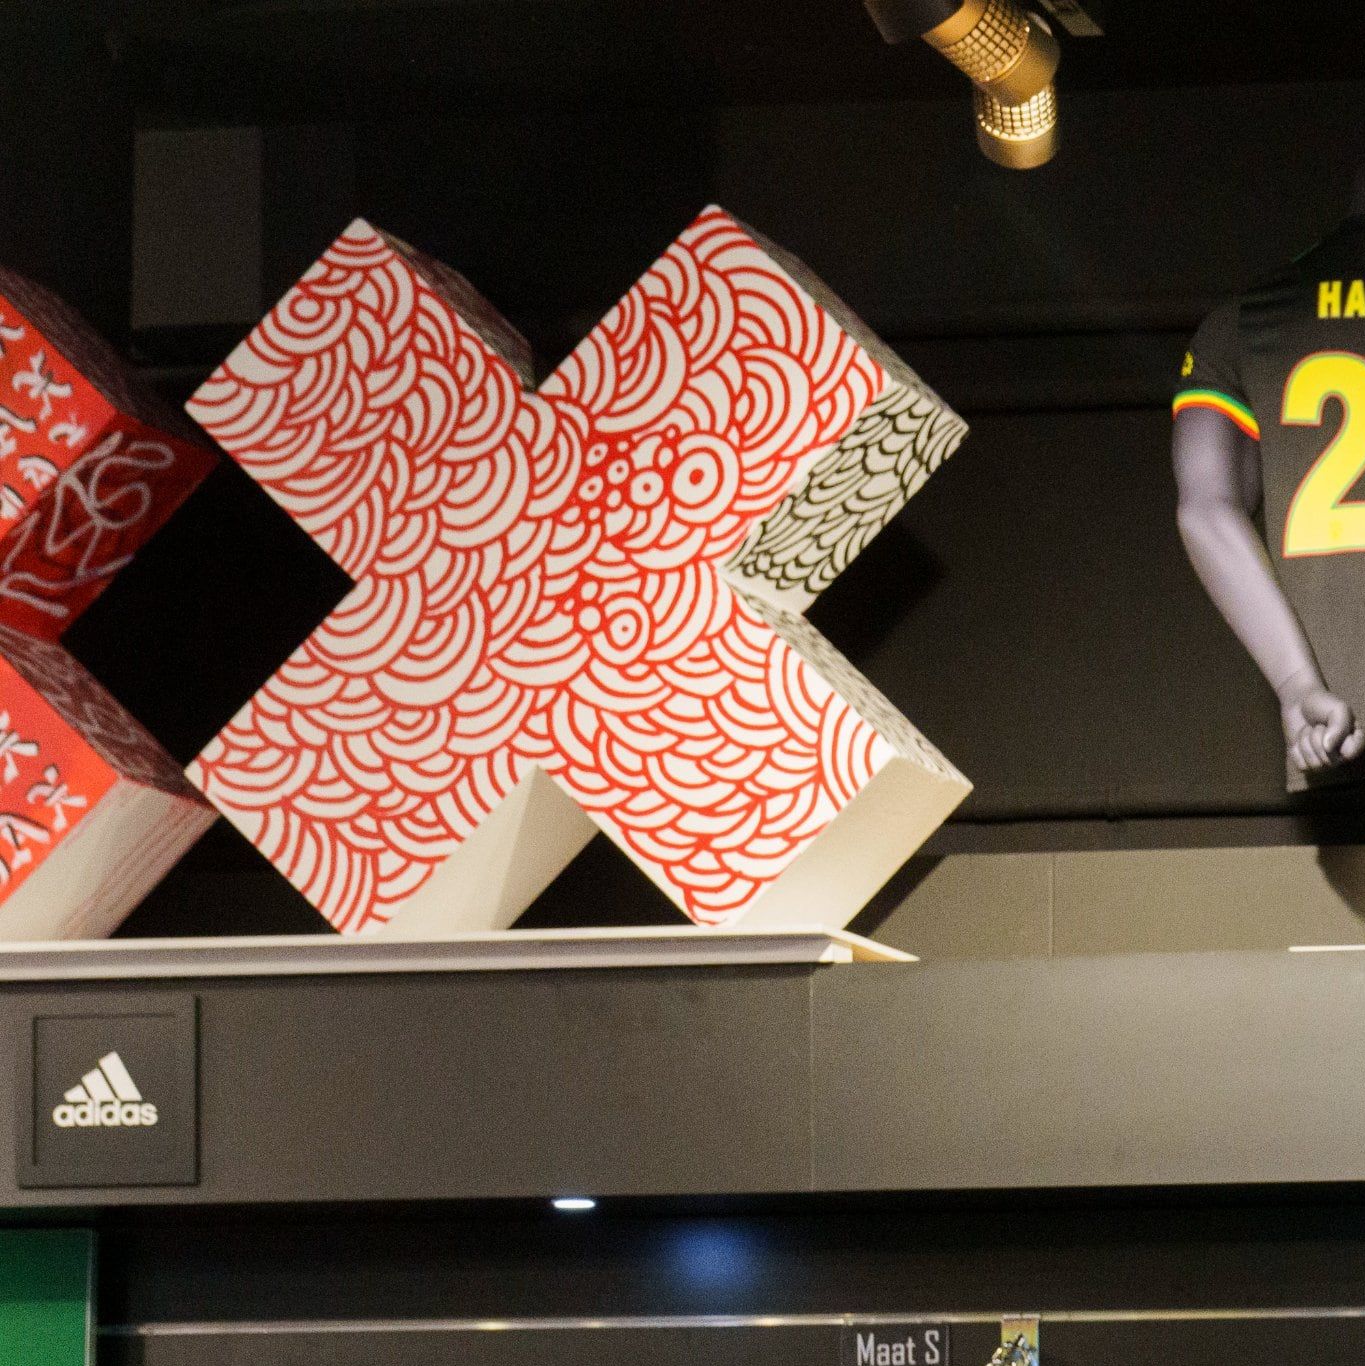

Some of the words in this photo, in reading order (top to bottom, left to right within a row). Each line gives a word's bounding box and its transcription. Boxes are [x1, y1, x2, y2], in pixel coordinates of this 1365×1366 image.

[52, 1098, 159, 1128] adidas
[856, 1332, 917, 1366] Maat
[924, 1329, 940, 1365] S
